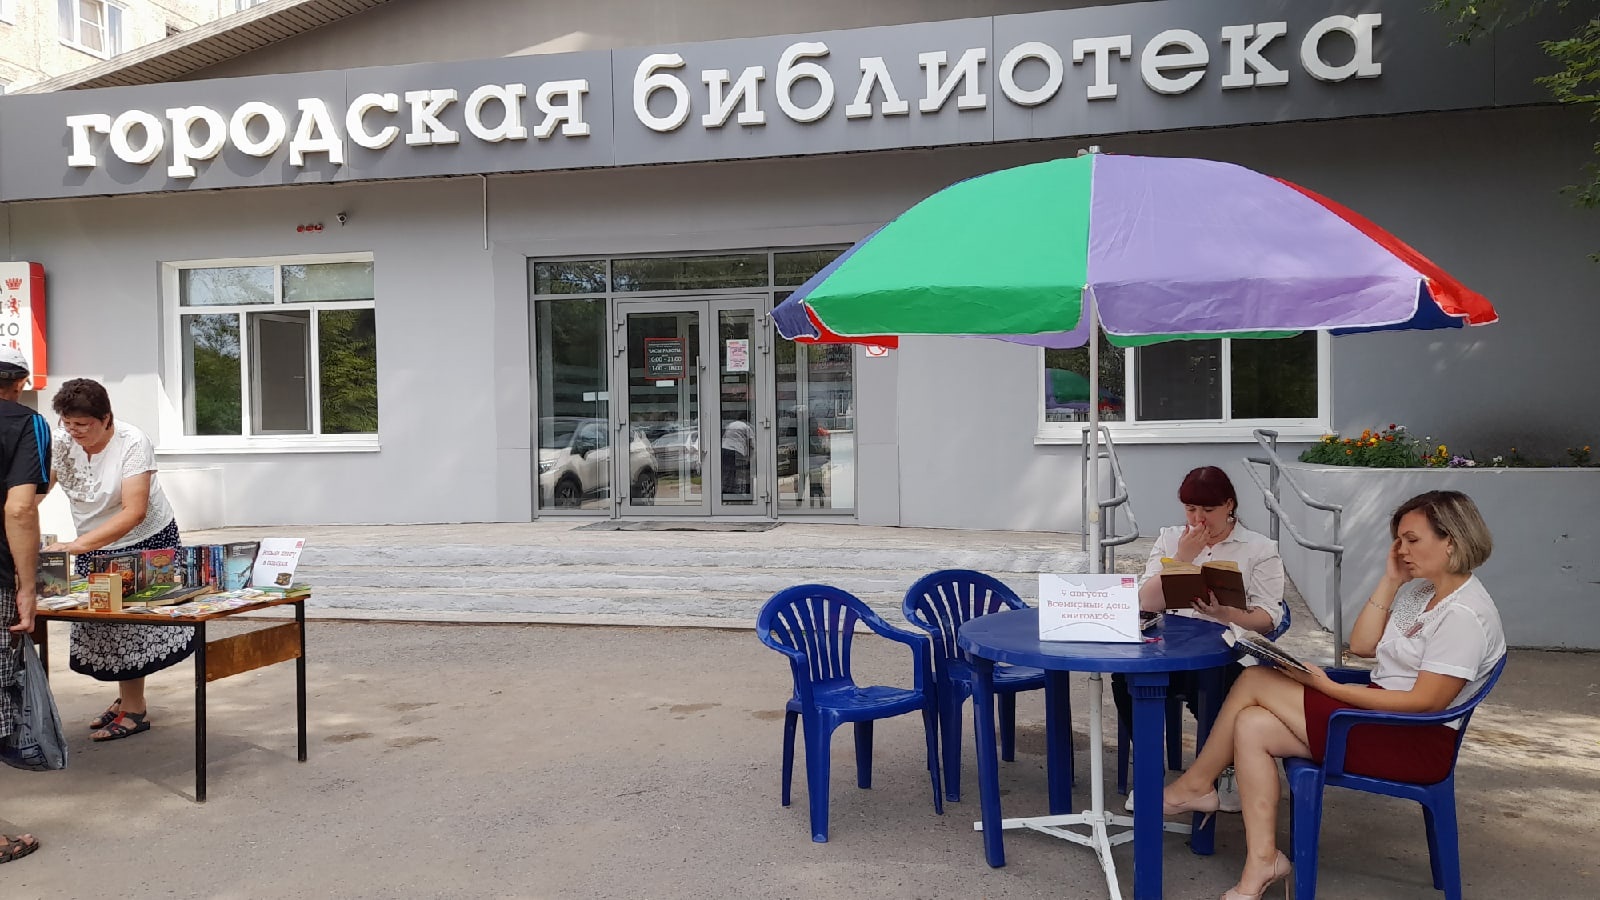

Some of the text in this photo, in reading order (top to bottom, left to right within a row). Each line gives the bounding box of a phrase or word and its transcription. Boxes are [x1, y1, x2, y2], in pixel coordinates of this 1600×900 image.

[66, 13, 1382, 178] городская библиотека
[1069, 590, 1109, 598] августа
[1047, 600, 1104, 610] Всемирный
